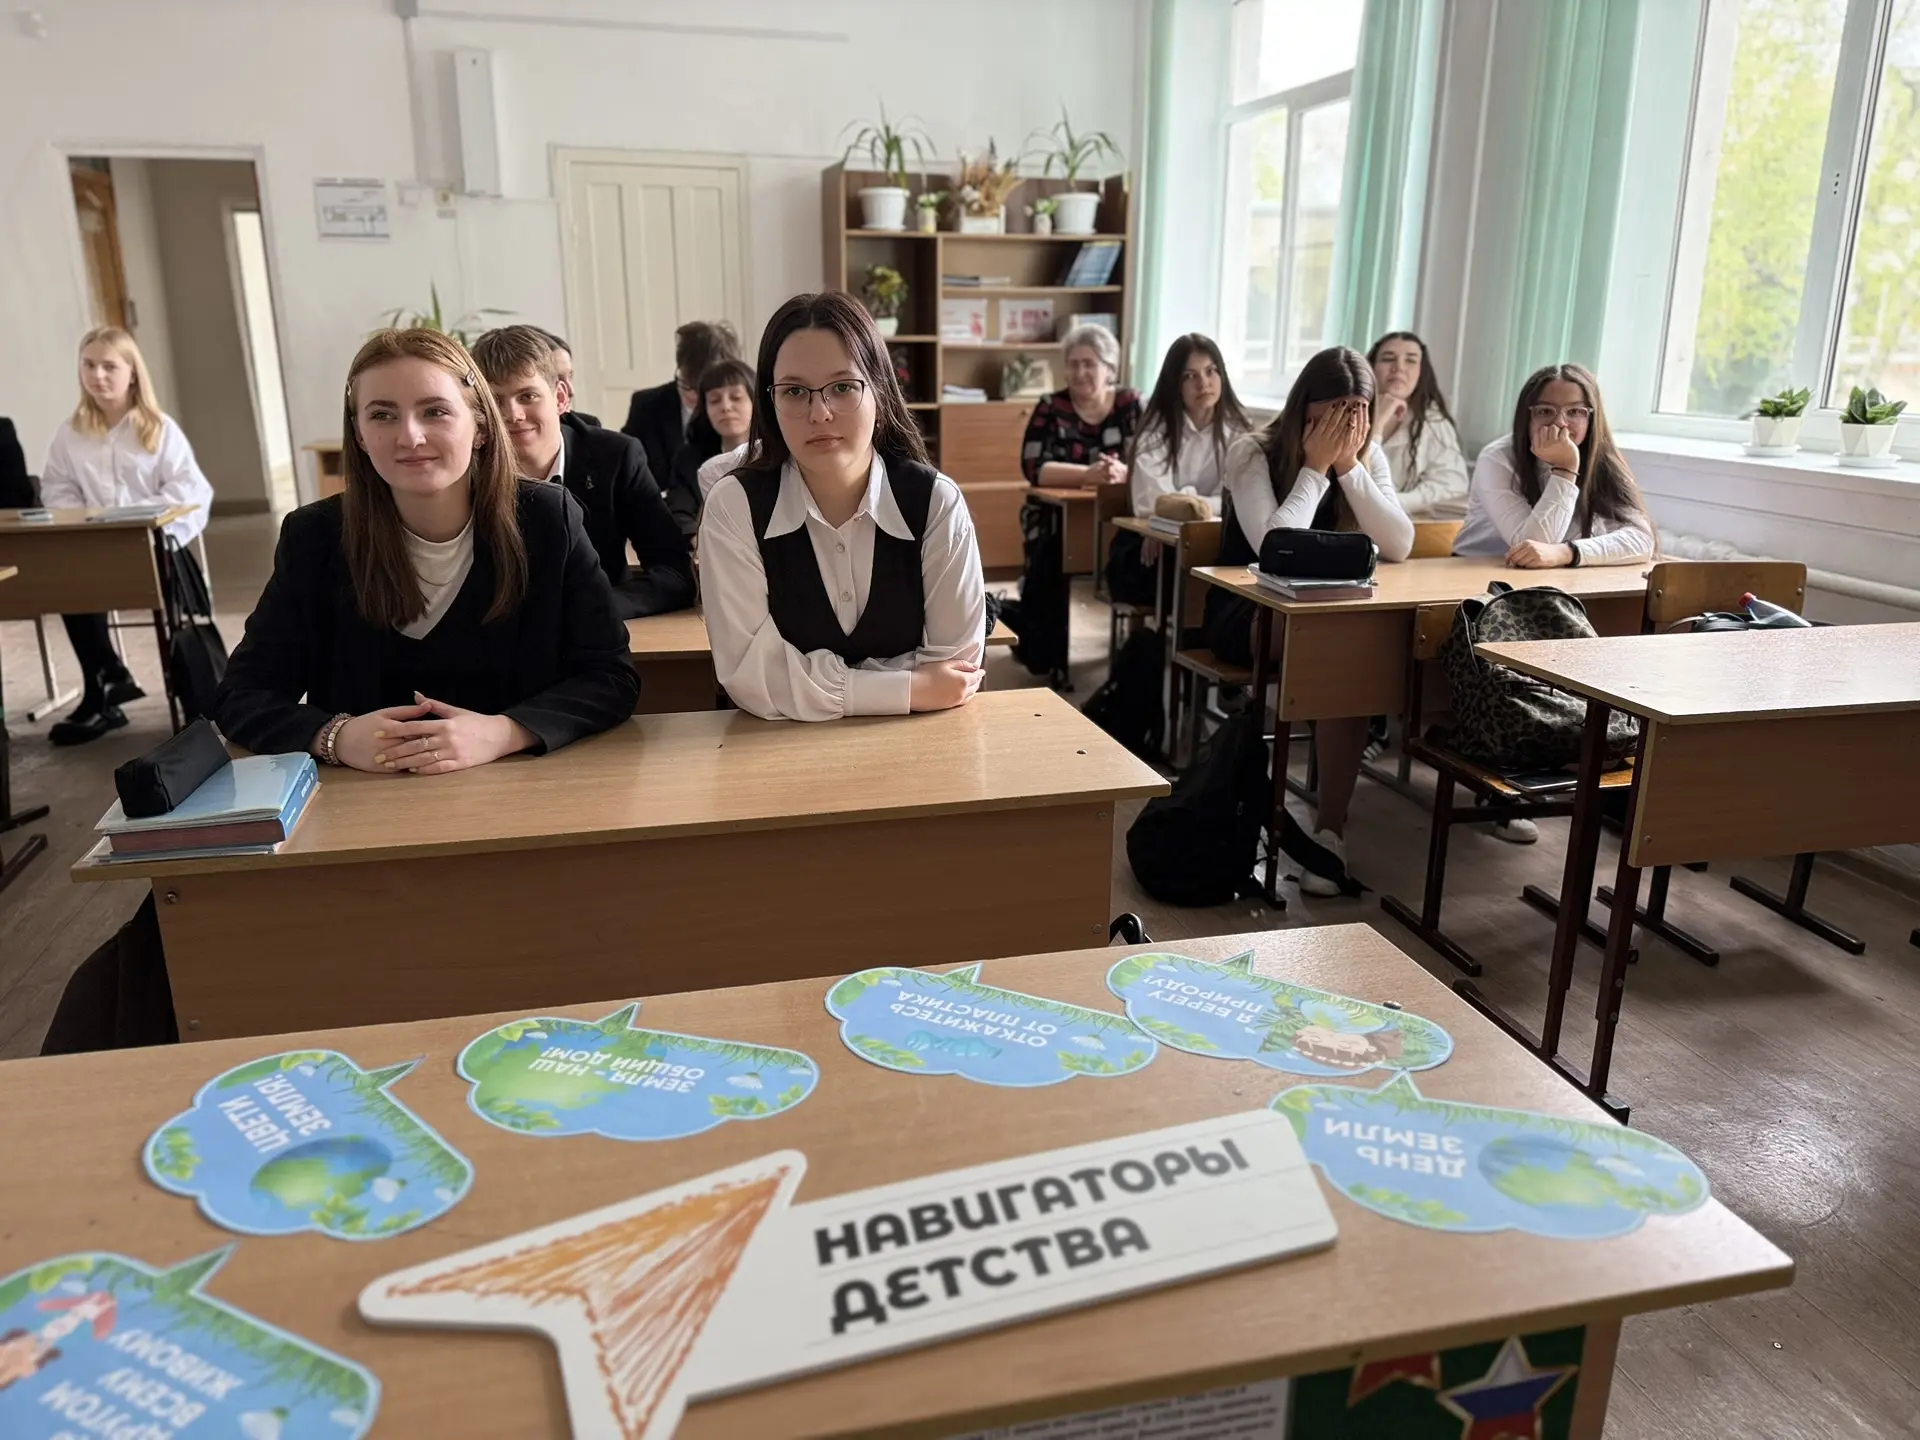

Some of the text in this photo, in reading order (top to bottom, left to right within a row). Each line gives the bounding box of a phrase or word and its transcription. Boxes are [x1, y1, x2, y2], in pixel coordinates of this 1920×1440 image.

[898, 990, 1057, 1035] ОТ ПЛАСТИКА
[1143, 975, 1264, 1014] ПРИРОДУ!
[1146, 990, 1256, 1024] Я БЕРЕГУ
[889, 1002, 1048, 1047] ОТКАЖИТЕСЬ
[528, 1058, 590, 1077] НАШ
[540, 1046, 706, 1081] ОБЩИЙ ДОМ!
[608, 1069, 696, 1093] ЗЕМЛЯ
[217, 1094, 292, 1153] ЦВЕТИ
[252, 1073, 332, 1137] ЗЕМЛЯ!
[1324, 1116, 1465, 1155] ЗЕМЛИ
[1356, 1145, 1467, 1178] ДЕНЬ
[814, 1138, 1250, 1266] НАВИГАТОРЫ
[830, 1217, 1151, 1335] ДЕТСТВА
[108, 1329, 245, 1401] ЖИВОМУ
[97, 1368, 207, 1429] ВСЕМУ
